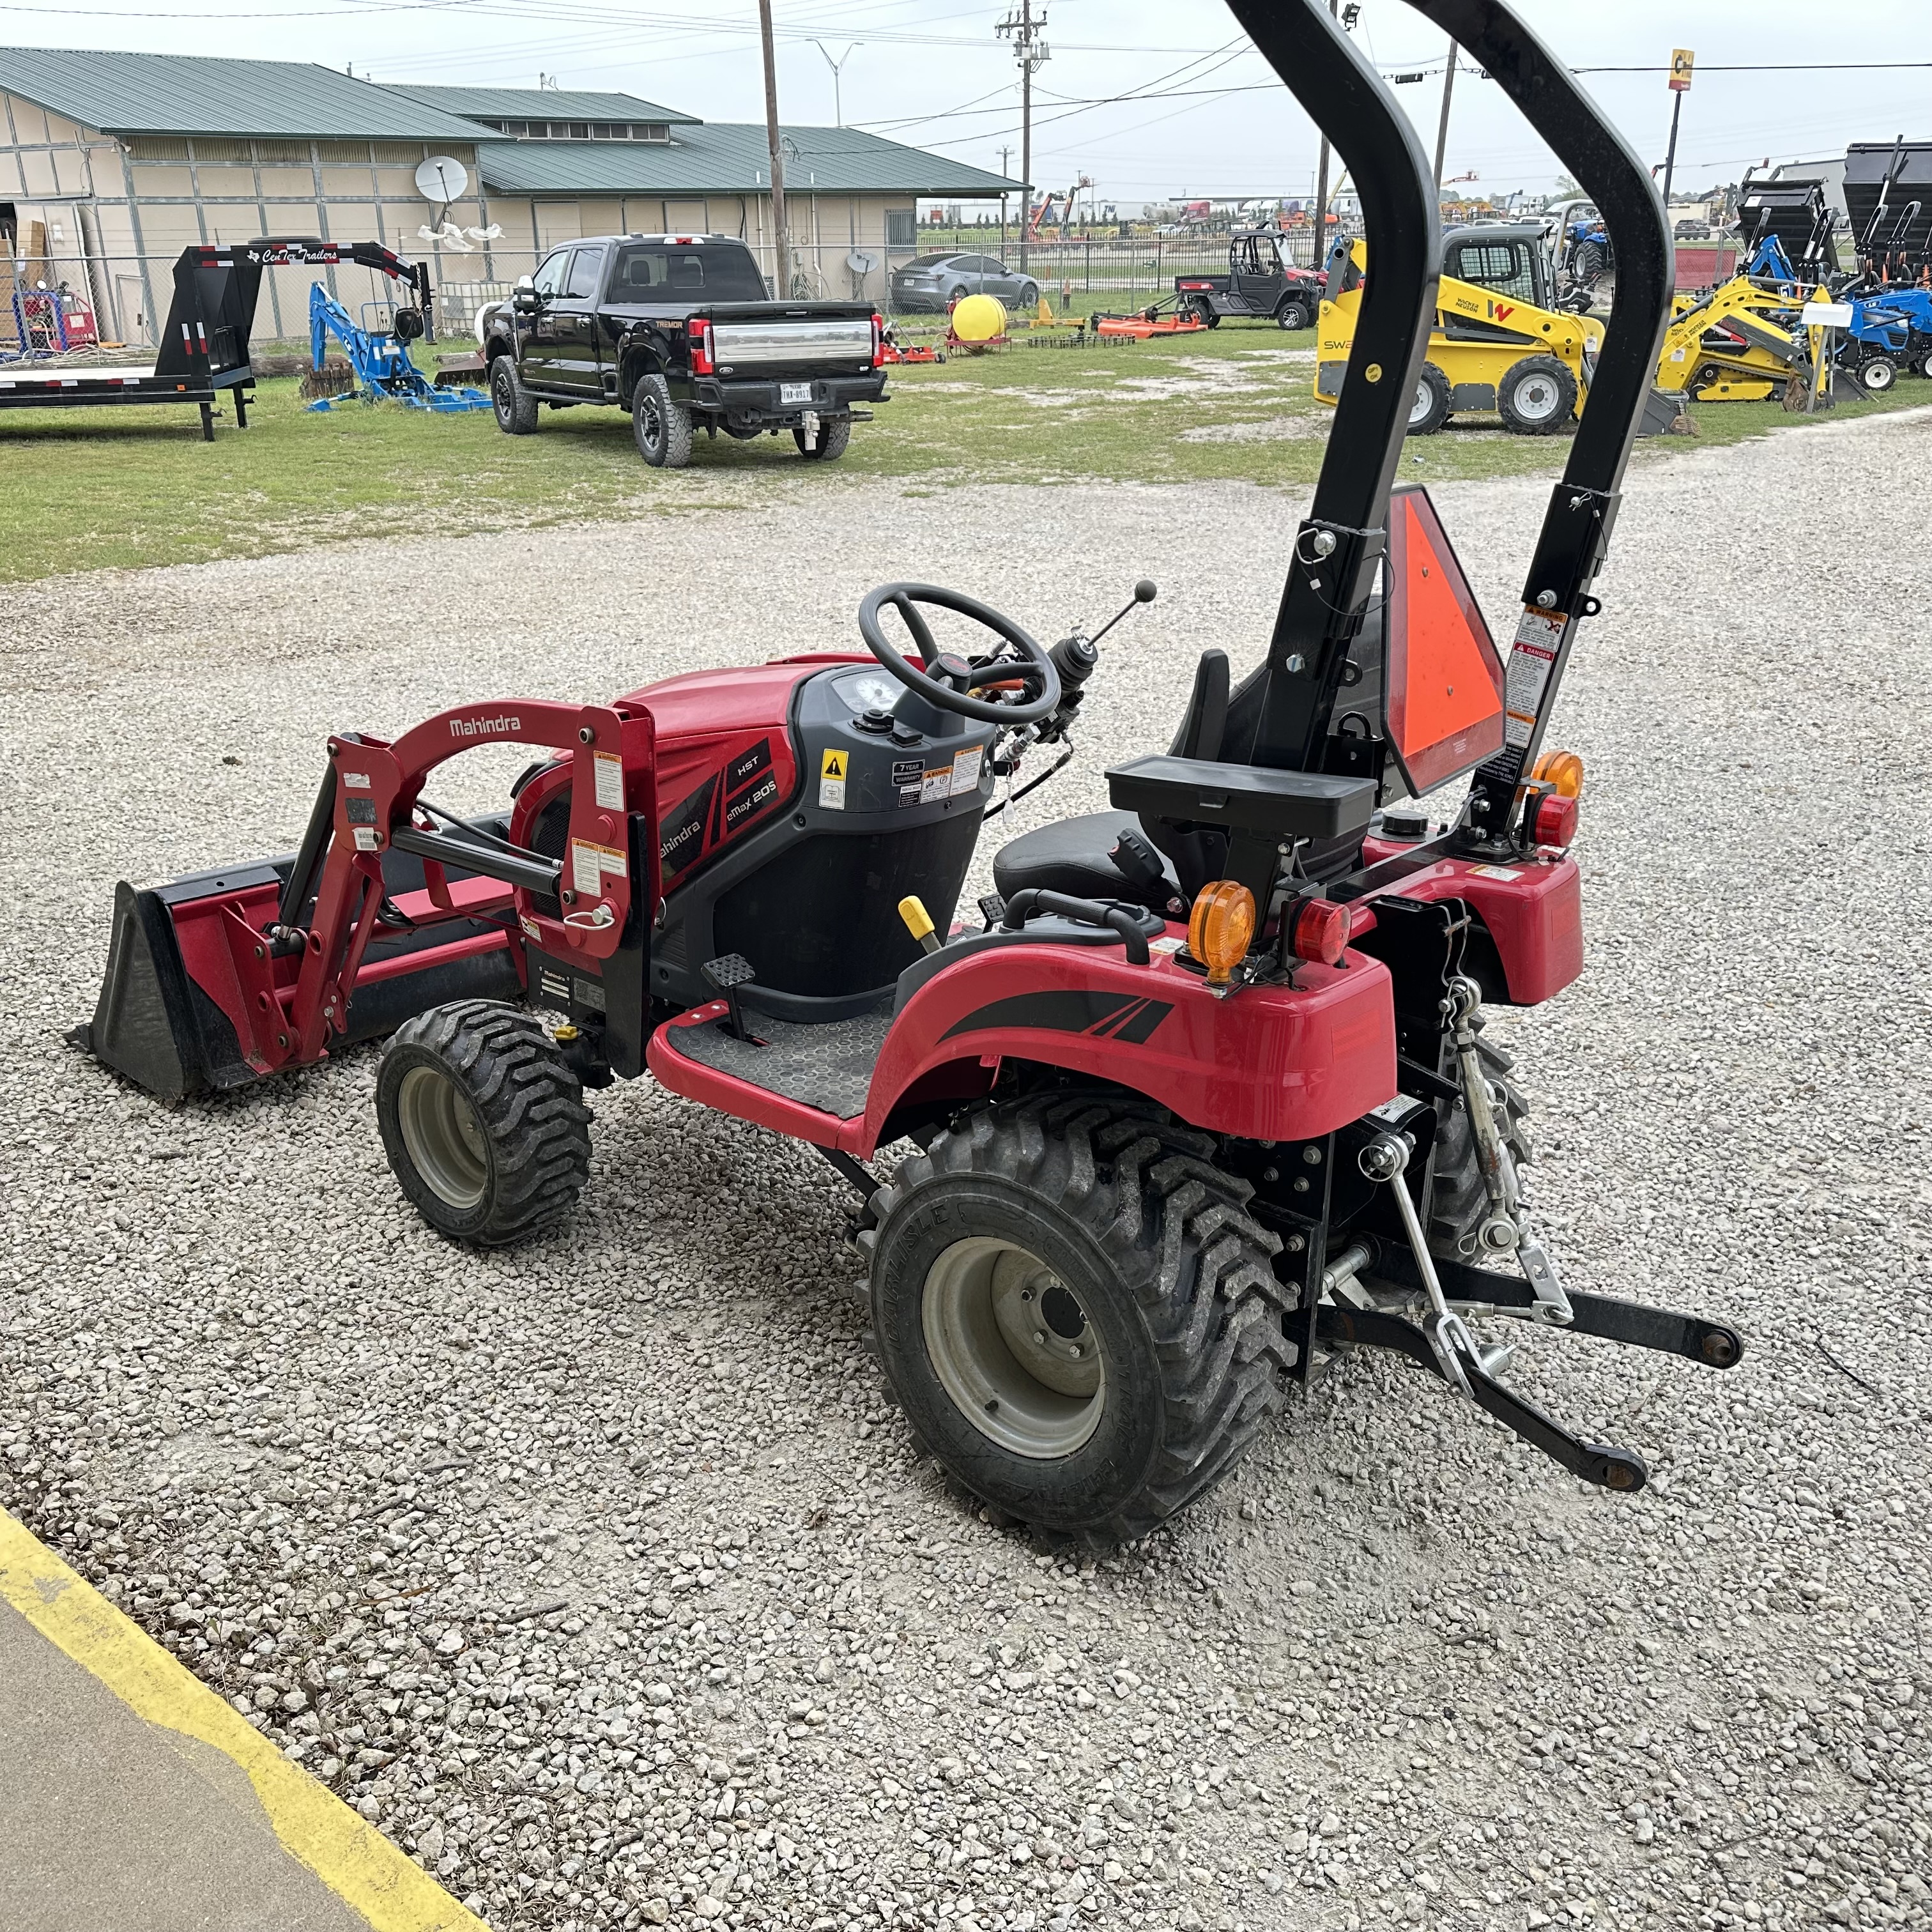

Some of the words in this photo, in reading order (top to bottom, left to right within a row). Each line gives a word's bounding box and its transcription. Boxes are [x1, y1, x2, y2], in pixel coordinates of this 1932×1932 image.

[263, 249, 296, 263] CenTex
[298, 249, 337, 261] Trailers
[1324, 341, 1353, 349] SW2
[1536, 610, 1563, 621] WARNING
[1527, 647, 1551, 659] DANGER
[449, 714, 521, 737] Mahindra
[737, 756, 758, 776] HST
[931, 769, 949, 777] WARNING
[726, 798, 752, 822] eMax
[752, 780, 776, 803] 20S
[660, 821, 701, 859] ahindra
[884, 1204, 949, 1349] CARLISLE
